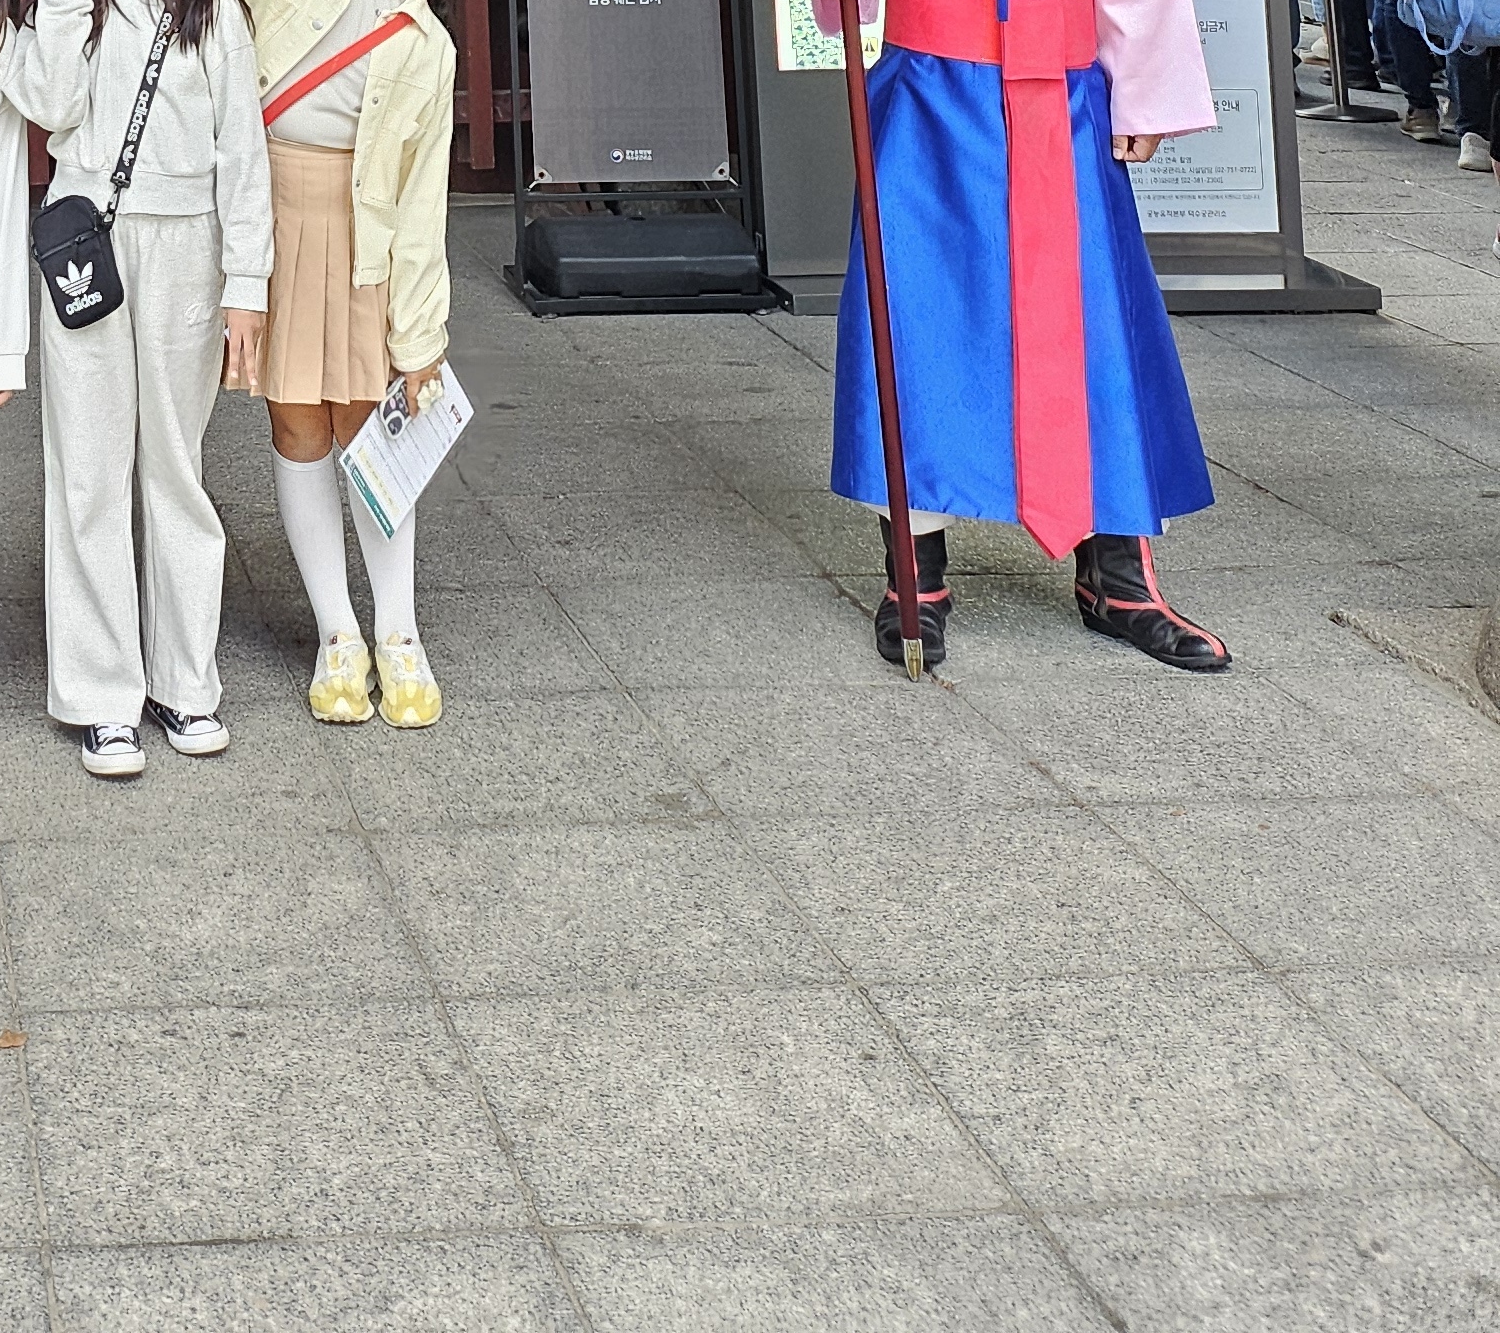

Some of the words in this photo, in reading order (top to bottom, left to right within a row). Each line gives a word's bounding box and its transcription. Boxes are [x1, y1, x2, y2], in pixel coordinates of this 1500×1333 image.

[1199, 20, 1228, 33] 입금지
[1221, 99, 1240, 112] 안내
[127, 89, 150, 142] adidas
[65, 292, 103, 316] adidas
